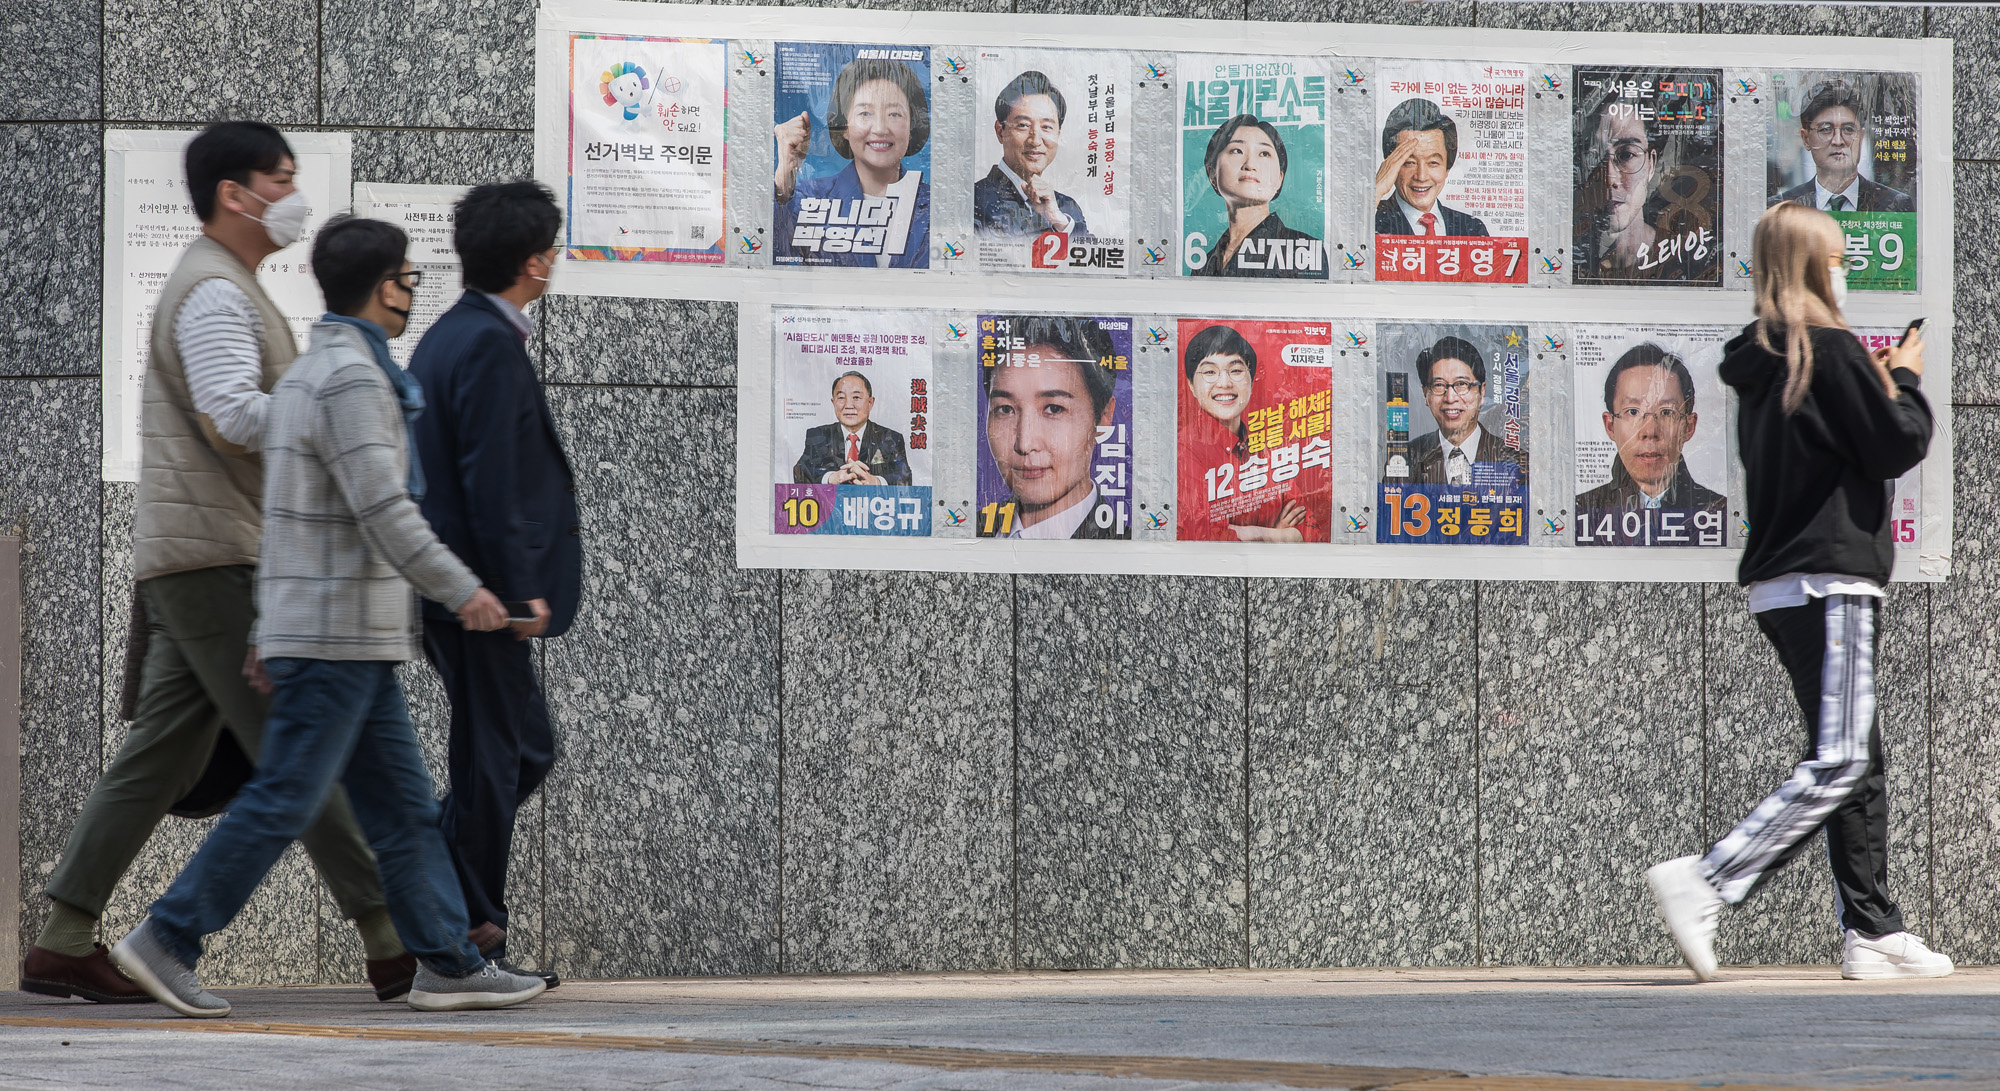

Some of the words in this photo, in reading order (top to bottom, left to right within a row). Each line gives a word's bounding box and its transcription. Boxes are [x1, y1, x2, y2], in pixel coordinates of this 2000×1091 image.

[857, 49, 890, 60] 서울시
[890, 50, 924, 61] 대전환
[1087, 74, 1099, 124] 첫날부터
[1390, 81, 1421, 94] 국가에
[1424, 82, 1444, 94] 돈이
[1447, 82, 1468, 95] 없는
[1472, 83, 1492, 96] 것이
[1495, 83, 1525, 97] 아니라
[1608, 80, 1655, 98] 서울은
[1658, 82, 1711, 100] 무지개
[1105, 83, 1116, 133] 서울부터
[1183, 76, 1326, 127] 서울기본소득
[1441, 96, 1482, 108] 도둑놈이
[1485, 97, 1524, 110] 많습니다
[1608, 103, 1654, 121] 이기는
[662, 119, 675, 132] 안
[677, 122, 701, 133] 돼요!
[1455, 110, 1470, 119] 국가
[1472, 110, 1493, 120] 미래를
[1494, 111, 1524, 120] 내다보는
[1469, 120, 1499, 129] 허경영이
[1500, 121, 1524, 130] 옳았다!
[1474, 130, 1482, 139] 그
[1483, 130, 1506, 140] 나물에
[1506, 131, 1515, 140] 그
[1516, 131, 1524, 140] 밥
[1476, 140, 1491, 149] 이제
[1492, 140, 1524, 150] 끝냅시다.
[1874, 140, 1890, 150] 서민
[584, 142, 654, 161] 선거벽보
[660, 144, 713, 165] 주의문
[1086, 128, 1099, 178] 능숙하게
[1457, 152, 1478, 160] 서울시
[1479, 152, 1493, 160] 예산
[1494, 152, 1508, 160] 70%
[1509, 152, 1525, 161] 절약!
[1874, 151, 1890, 162] 서울
[1891, 152, 1907, 162] 혁명
[138, 203, 178, 214] 선거인명부
[1656, 165, 1712, 233] 8
[404, 212, 444, 222] 사전투표소
[797, 197, 894, 226] 합니다
[886, 170, 923, 255] 1
[1863, 221, 1888, 230] 제3정치
[1889, 221, 1903, 230] 대표
[791, 226, 888, 254] 박영선
[1042, 234, 1061, 267] 2
[1072, 237, 1125, 246] 서울특별시장후보
[1184, 231, 1208, 270] 6
[1636, 227, 1714, 271] 오태양
[1878, 232, 1904, 271] 9
[1069, 246, 1124, 269] 오세훈
[1238, 238, 1323, 271] 신지혜
[1402, 246, 1493, 276] 허경영
[1502, 249, 1522, 278] 7
[981, 319, 1011, 334] 여자
[1098, 321, 1128, 331] 여성의당
[1303, 326, 1327, 336] 진보당
[801, 344, 839, 354] 메디컬시티
[840, 345, 858, 355] 조성,
[860, 345, 890, 356] 복지정책
[891, 346, 908, 356] 확대,
[831, 333, 861, 343] 에덴동산
[862, 334, 878, 344] 공원
[880, 335, 909, 345] 100만평
[910, 335, 928, 346] 조성,
[981, 336, 1027, 351] 혼자도
[835, 356, 873, 366] 예산효율화
[981, 352, 1042, 368] 살기좋은
[1098, 355, 1128, 370] 서울
[1290, 355, 1325, 364] 지지후보
[1492, 352, 1502, 373] 3시
[1504, 352, 1520, 384] 서울
[1247, 403, 1285, 432] 강남
[1289, 389, 1331, 421] 해체!
[1505, 386, 1521, 419] 경제
[1247, 425, 1284, 454] 평등
[1288, 411, 1331, 442] 서울!
[1094, 423, 1128, 535] 김진아
[1204, 462, 1235, 503] 12
[1238, 435, 1331, 493] 송명숙
[791, 488, 814, 497] 기호
[783, 497, 820, 528] 10
[843, 496, 923, 531] 배영규
[981, 502, 1016, 533] 11
[1384, 493, 1431, 537] 13
[1436, 507, 1523, 537] 정동희
[1577, 513, 1616, 542] 14
[1622, 509, 1723, 546] 이도엽
[1891, 519, 1915, 543] 15
